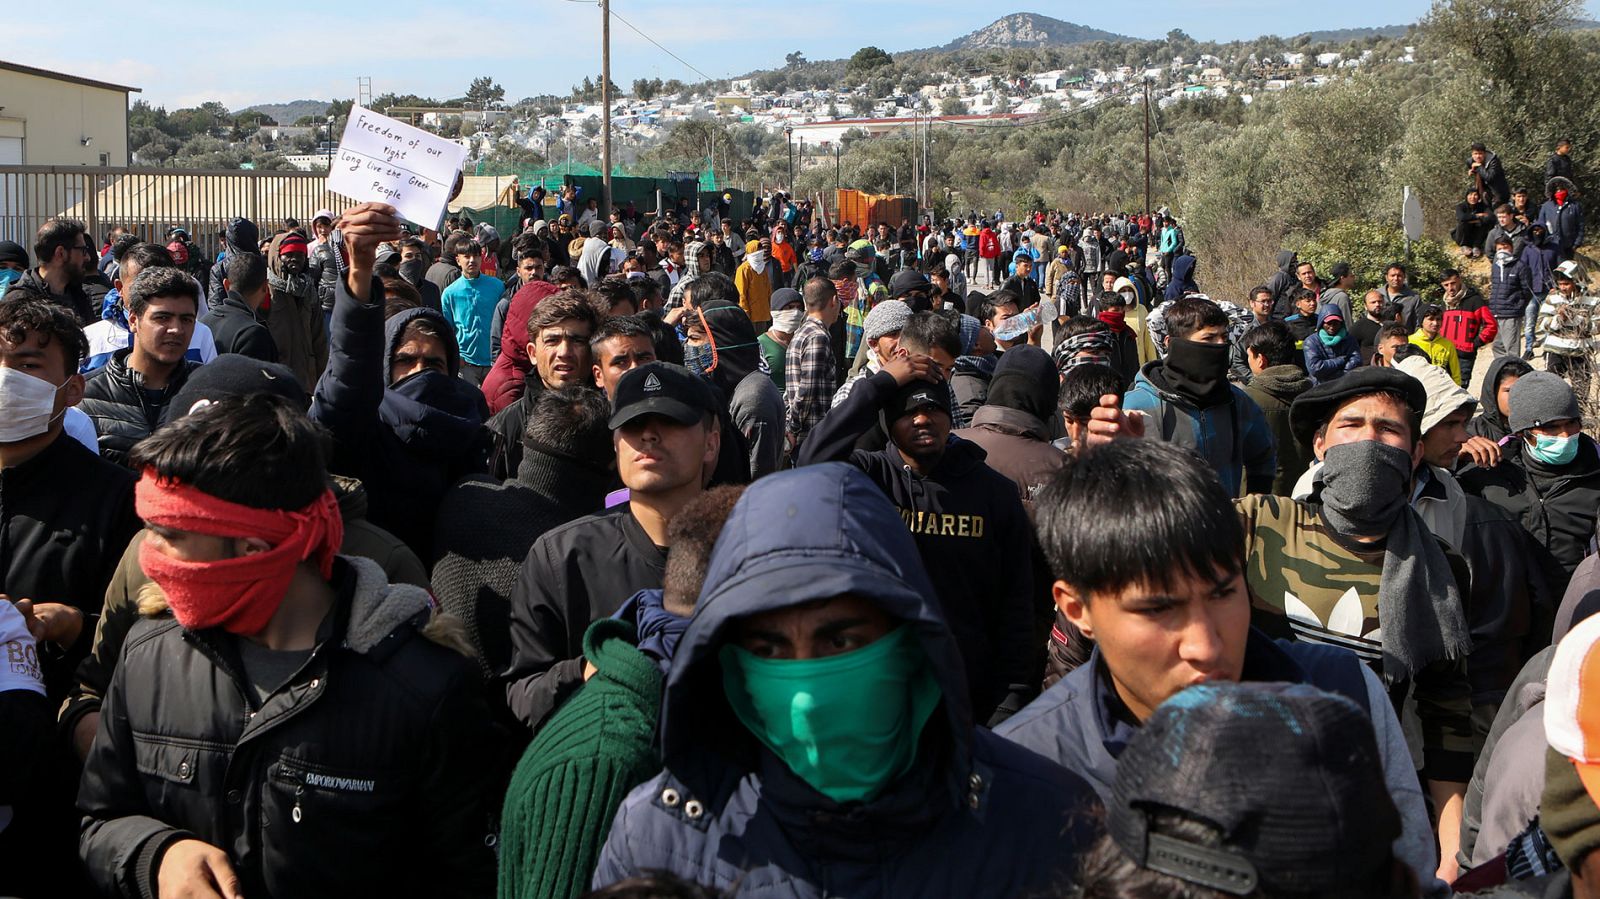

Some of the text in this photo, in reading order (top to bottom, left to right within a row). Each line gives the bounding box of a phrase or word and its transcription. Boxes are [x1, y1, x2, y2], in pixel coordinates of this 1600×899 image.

[356, 114, 443, 158] Freedom of our
[383, 146, 407, 162] right
[341, 152, 362, 172] Long
[386, 168, 401, 179] the
[408, 176, 430, 190] Greek
[371, 181, 401, 200] People
